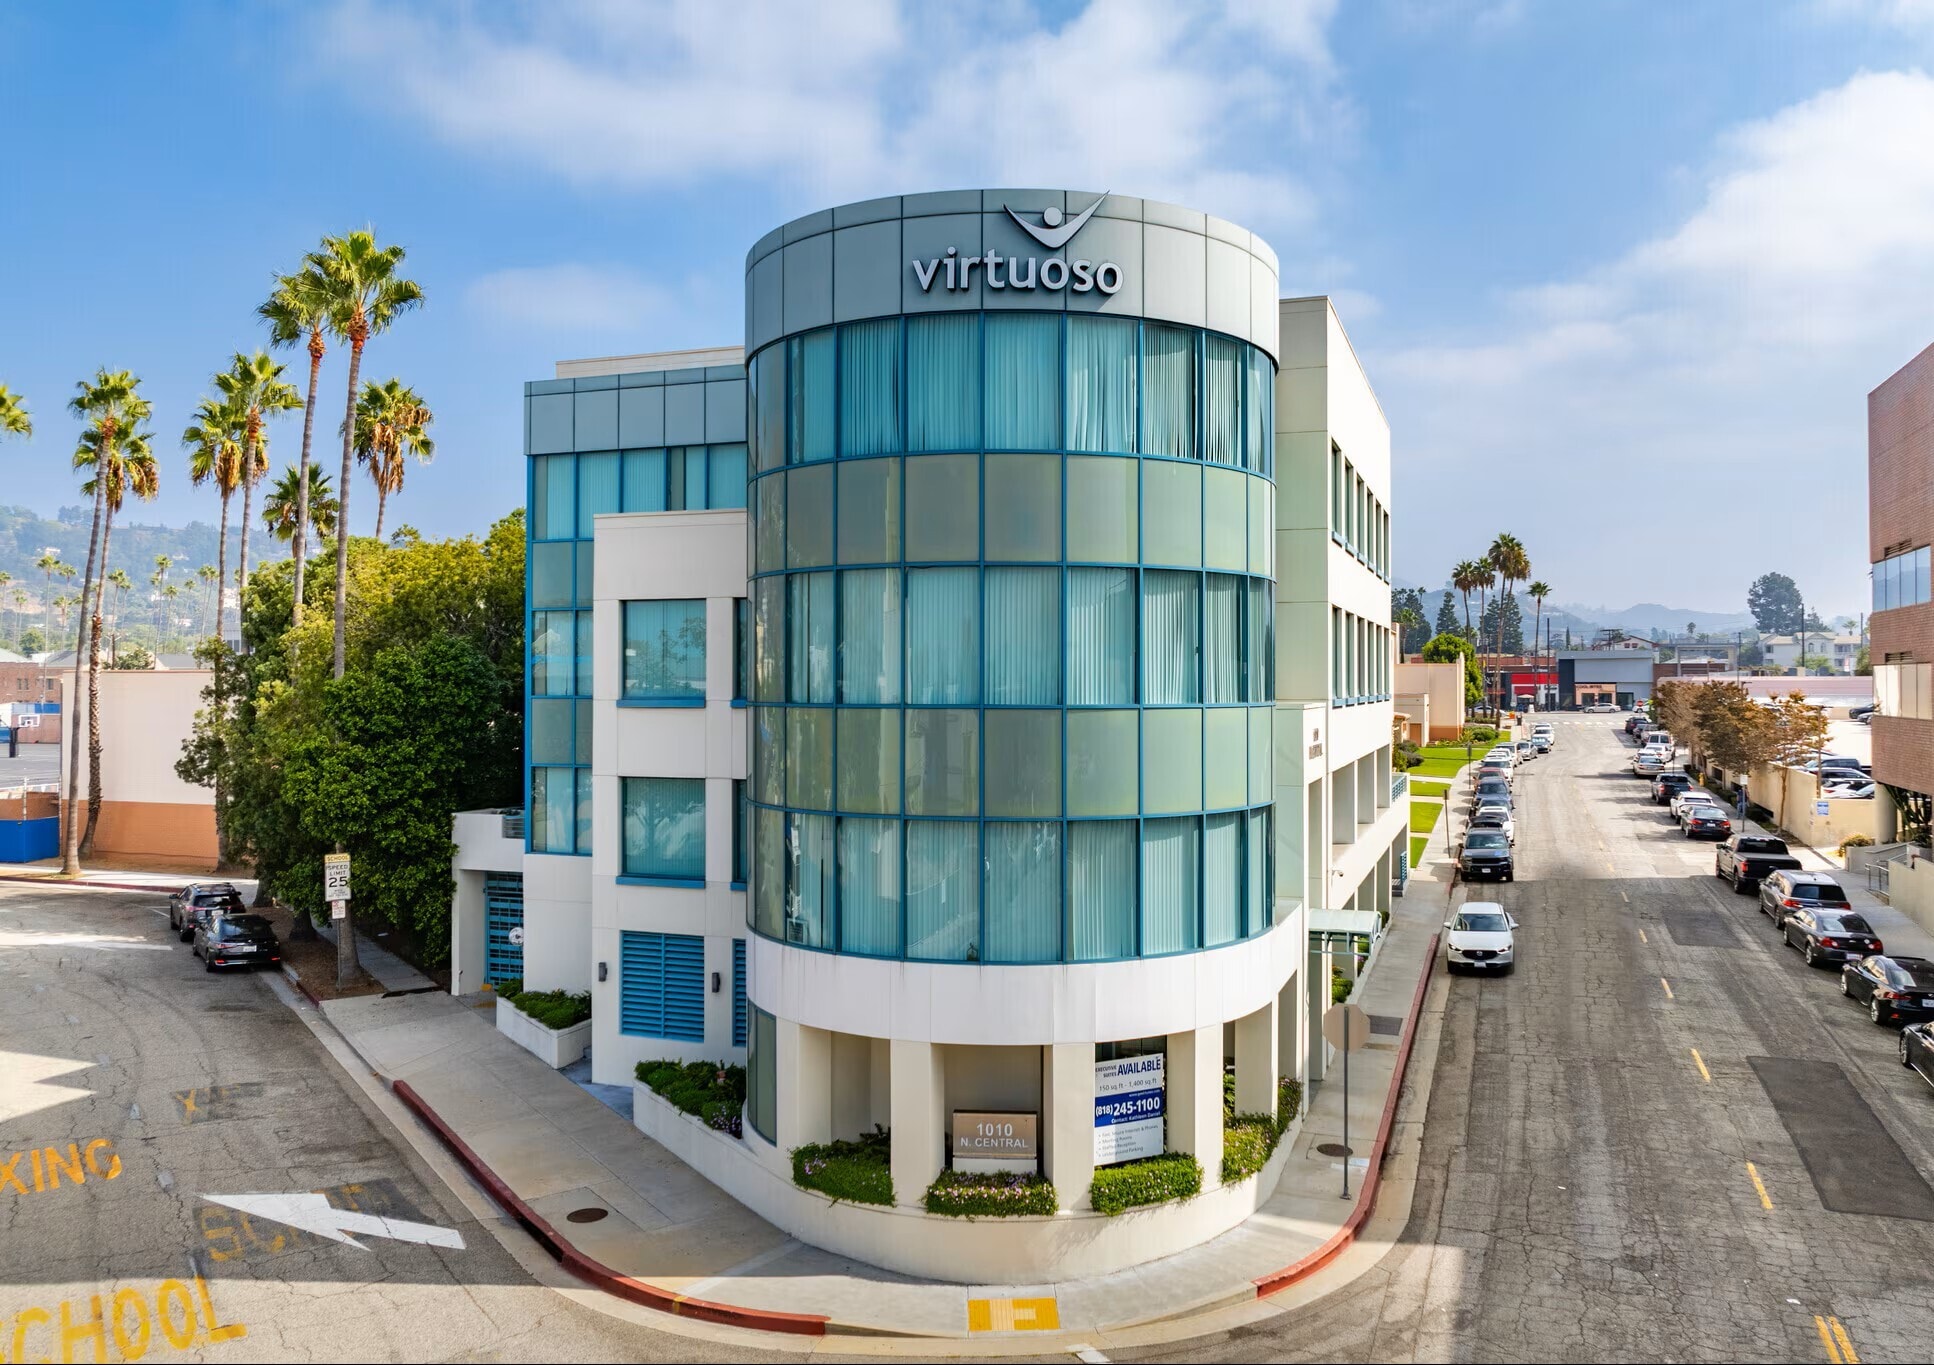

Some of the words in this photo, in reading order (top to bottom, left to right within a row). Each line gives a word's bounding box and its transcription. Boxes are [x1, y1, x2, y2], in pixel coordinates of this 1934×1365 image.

[912, 246, 1124, 294] virtuoso
[328, 876, 348, 888] 25
[1117, 1059, 1161, 1076] AVAILABLE
[1095, 1104, 1113, 1117] (818)
[1113, 1097, 1160, 1116] 245-1100
[976, 1123, 1013, 1137] 1010
[960, 1137, 972, 1147] N.
[974, 1138, 1029, 1148] CENTRAL
[0, 1138, 122, 1195] XING
[0, 1274, 248, 1364] CHOOL
